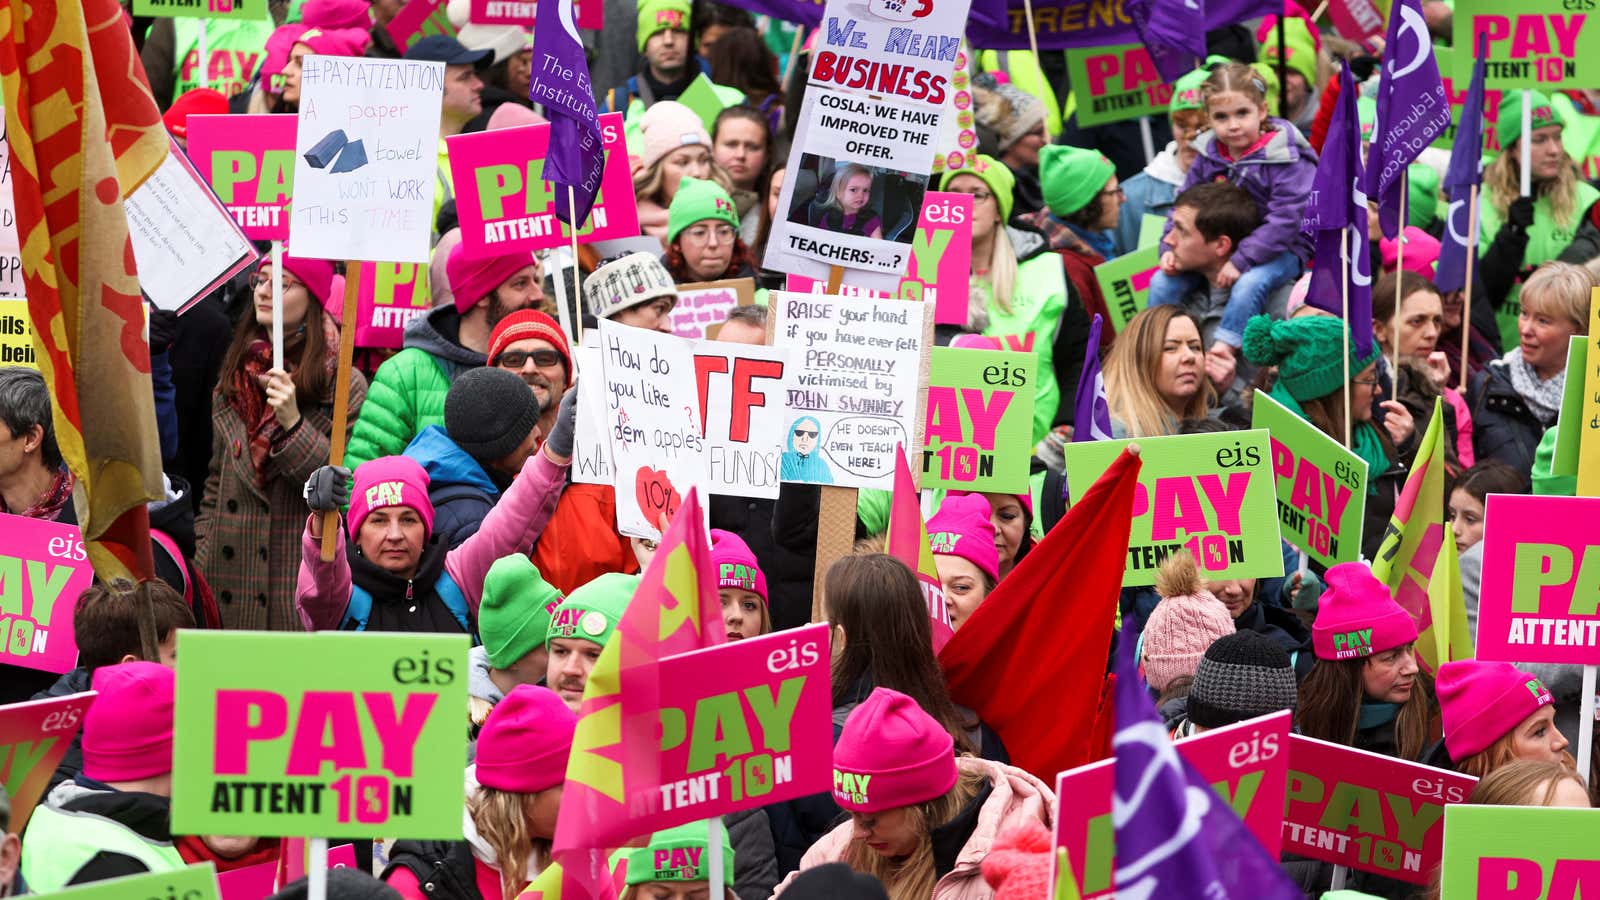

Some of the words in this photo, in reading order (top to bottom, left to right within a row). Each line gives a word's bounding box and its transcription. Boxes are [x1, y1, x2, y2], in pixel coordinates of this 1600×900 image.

[828, 17, 868, 49] WE
[1473, 13, 1587, 59] PAY
[303, 60, 443, 91] #PAYATTENTION
[544, 54, 573, 81] The
[813, 51, 947, 105] BUSINESS
[1085, 48, 1159, 97] PA
[1484, 57, 1575, 83] TTENT10N
[305, 98, 317, 120] A
[349, 104, 409, 128] paper
[532, 77, 595, 120] Institute
[820, 94, 871, 115] COSLA:
[875, 105, 897, 120] WE
[901, 110, 939, 127] HAVE
[820, 115, 898, 141] IMPROVED
[902, 130, 929, 146] THE
[376, 137, 423, 161] towel
[845, 140, 894, 160] OFFER.
[211, 150, 296, 204] PA
[388, 177, 425, 200] WORK
[298, 205, 349, 225] THIS
[366, 207, 416, 231] TIME
[485, 207, 608, 244] ATTENTN
[925, 200, 965, 224] eis
[789, 235, 875, 264] TEACHERS:
[0, 316, 25, 335] ils
[787, 300, 833, 319] RAISE
[839, 308, 870, 326] your
[873, 305, 908, 325] hand
[787, 324, 799, 338] if
[806, 331, 827, 347] you
[835, 329, 866, 346] have
[868, 337, 894, 348] ever
[896, 337, 919, 351] felt
[609, 336, 641, 371] How
[650, 345, 670, 376] do
[805, 350, 896, 373] PERSONALLY
[798, 375, 869, 390] victimised
[875, 378, 893, 396] by
[982, 362, 1026, 387] eis
[609, 380, 637, 410] you
[641, 380, 670, 408] like
[785, 390, 828, 408] JOHN
[838, 395, 904, 417] SWINNEY
[837, 424, 851, 435] HE
[858, 424, 900, 436] DOESN'T
[924, 386, 1015, 451] AY
[655, 427, 703, 458] apples
[831, 442, 853, 452] EVEN
[860, 443, 893, 453] TEACH
[1216, 441, 1261, 468] eis
[710, 445, 783, 487] FUNDS?
[848, 456, 881, 469] HERE!
[1335, 459, 1360, 490] eis
[366, 482, 404, 505] PAY
[644, 481, 674, 515] 10%
[1277, 502, 1338, 560] TENT10N
[48, 534, 87, 561] eis
[720, 563, 757, 582] PAY
[0, 555, 75, 627] AY
[1333, 628, 1372, 651] PAY
[1507, 618, 1600, 647] ATTENT
[393, 650, 454, 685] eis
[767, 640, 819, 673] eis
[41, 705, 82, 732] eis
[213, 689, 439, 778] PAY
[1228, 731, 1280, 768] eis
[833, 768, 871, 796] PAY
[1412, 778, 1464, 803] eis
[211, 774, 413, 825] ATTENT10N
[1284, 769, 1444, 850] PAY
[654, 847, 702, 870] PAY
